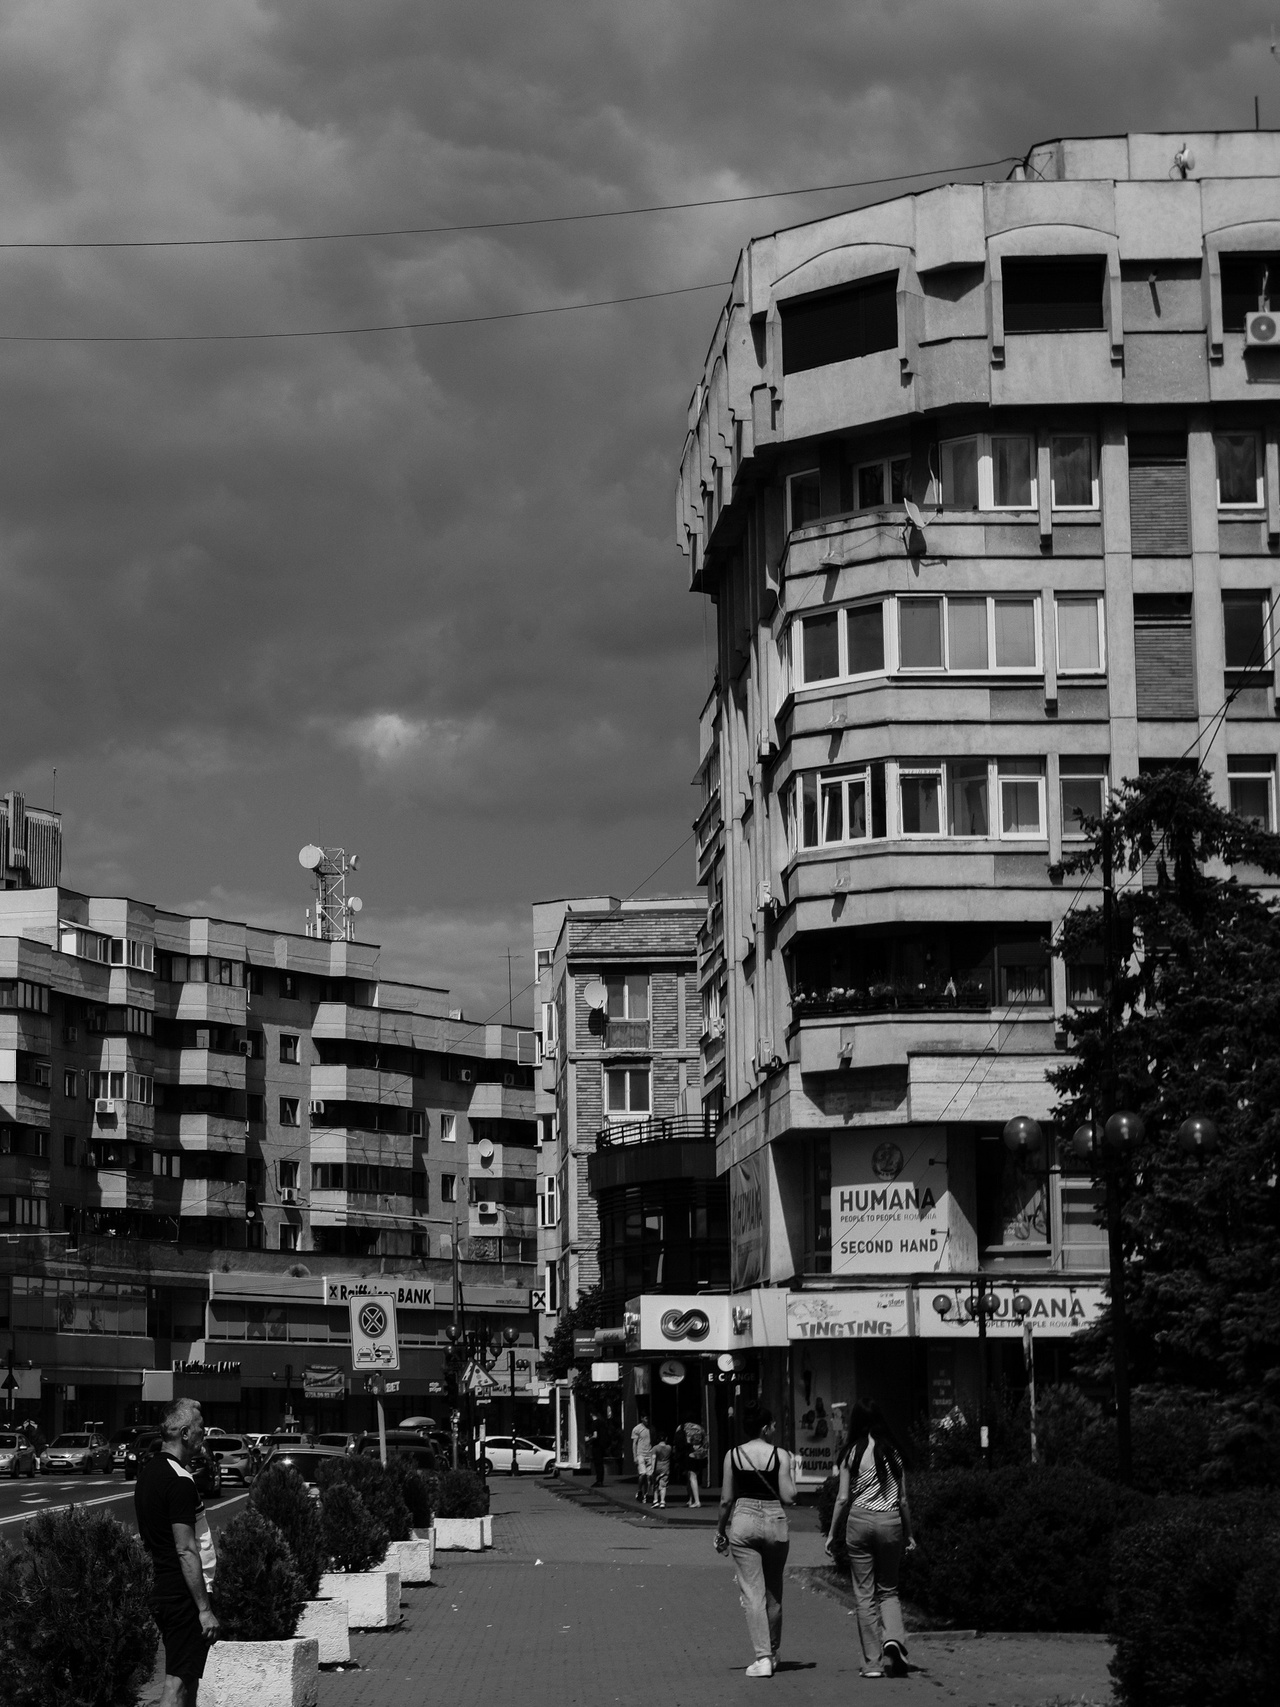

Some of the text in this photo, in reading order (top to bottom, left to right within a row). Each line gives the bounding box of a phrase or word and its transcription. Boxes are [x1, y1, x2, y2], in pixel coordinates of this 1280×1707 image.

[840, 1187, 936, 1212] HUMANA
[840, 1214, 865, 1223] PEOPLE
[867, 1214, 875, 1222] TO
[876, 1213, 901, 1222] PEOPLE
[840, 1238, 939, 1254] SECOND HAND
[397, 1287, 432, 1304] BANK
[799, 1447, 831, 1458] SCHIMB
